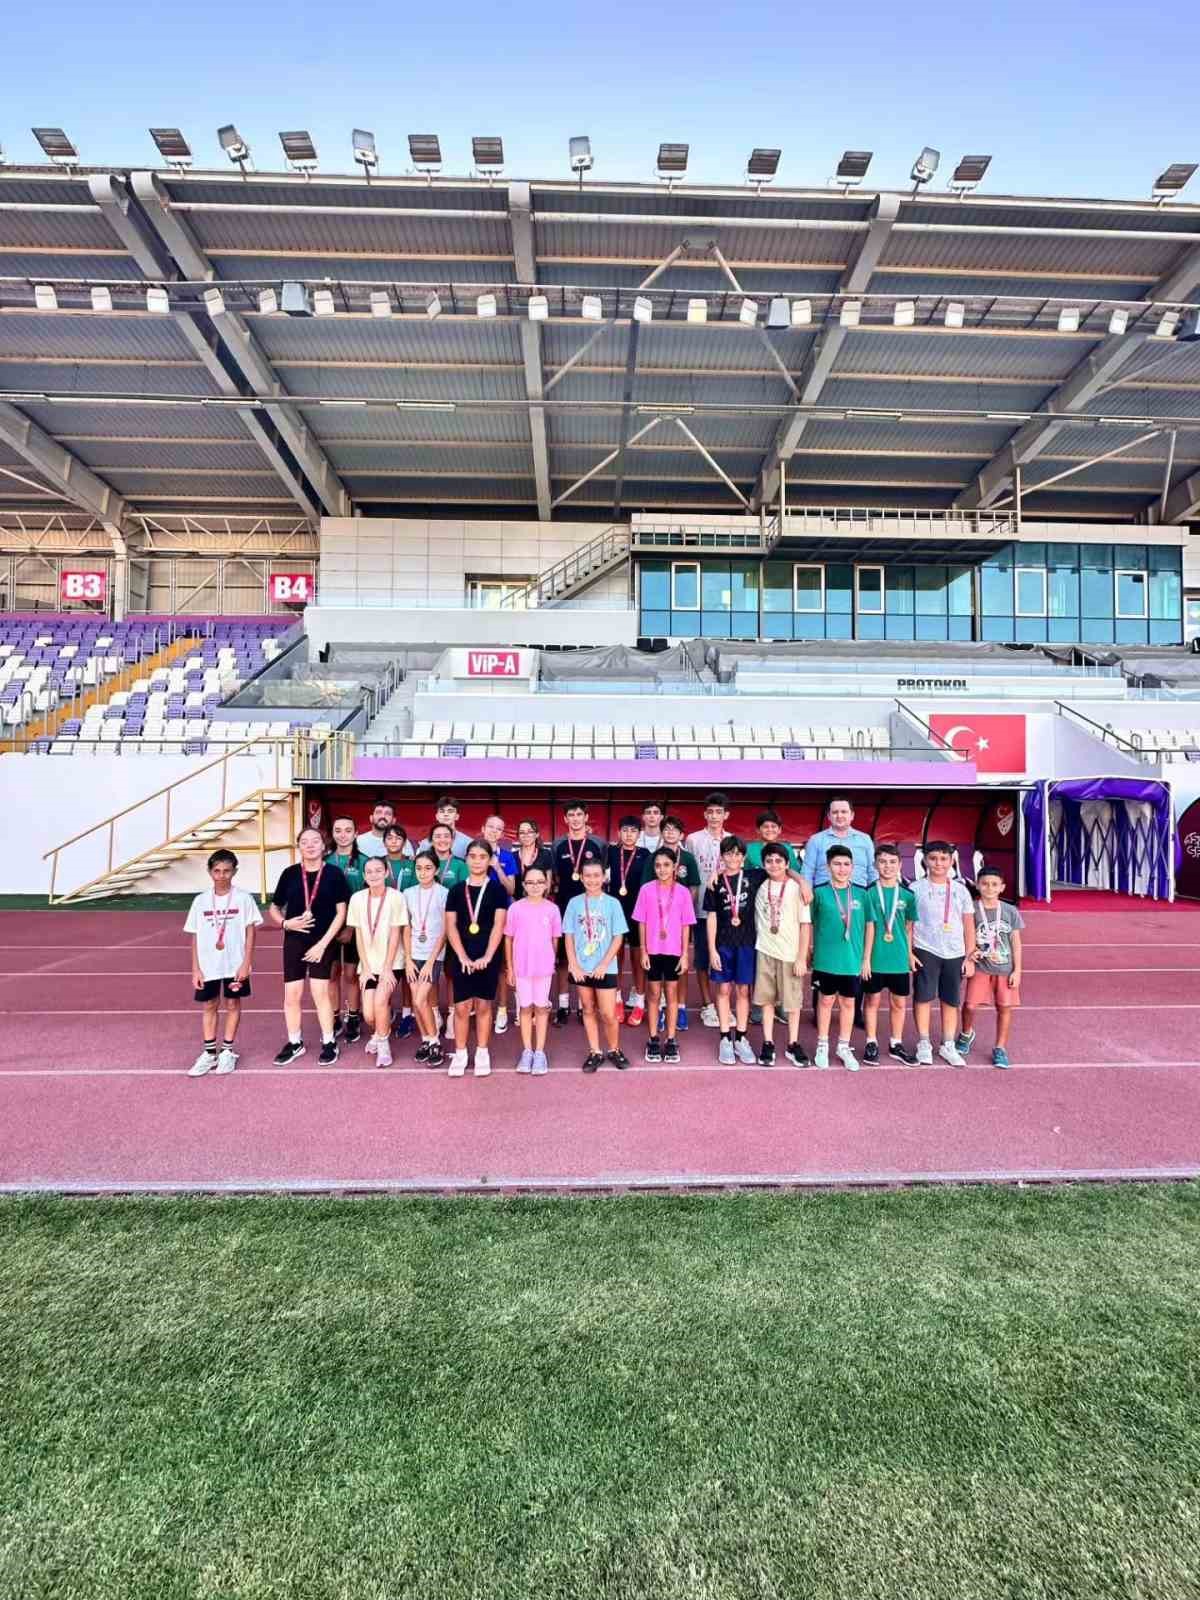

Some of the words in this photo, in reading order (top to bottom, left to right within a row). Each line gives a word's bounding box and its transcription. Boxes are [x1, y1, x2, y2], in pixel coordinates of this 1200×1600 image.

[66, 574, 101, 598] B3
[274, 576, 308, 599] B4
[897, 679, 969, 691] PROTOKOL
